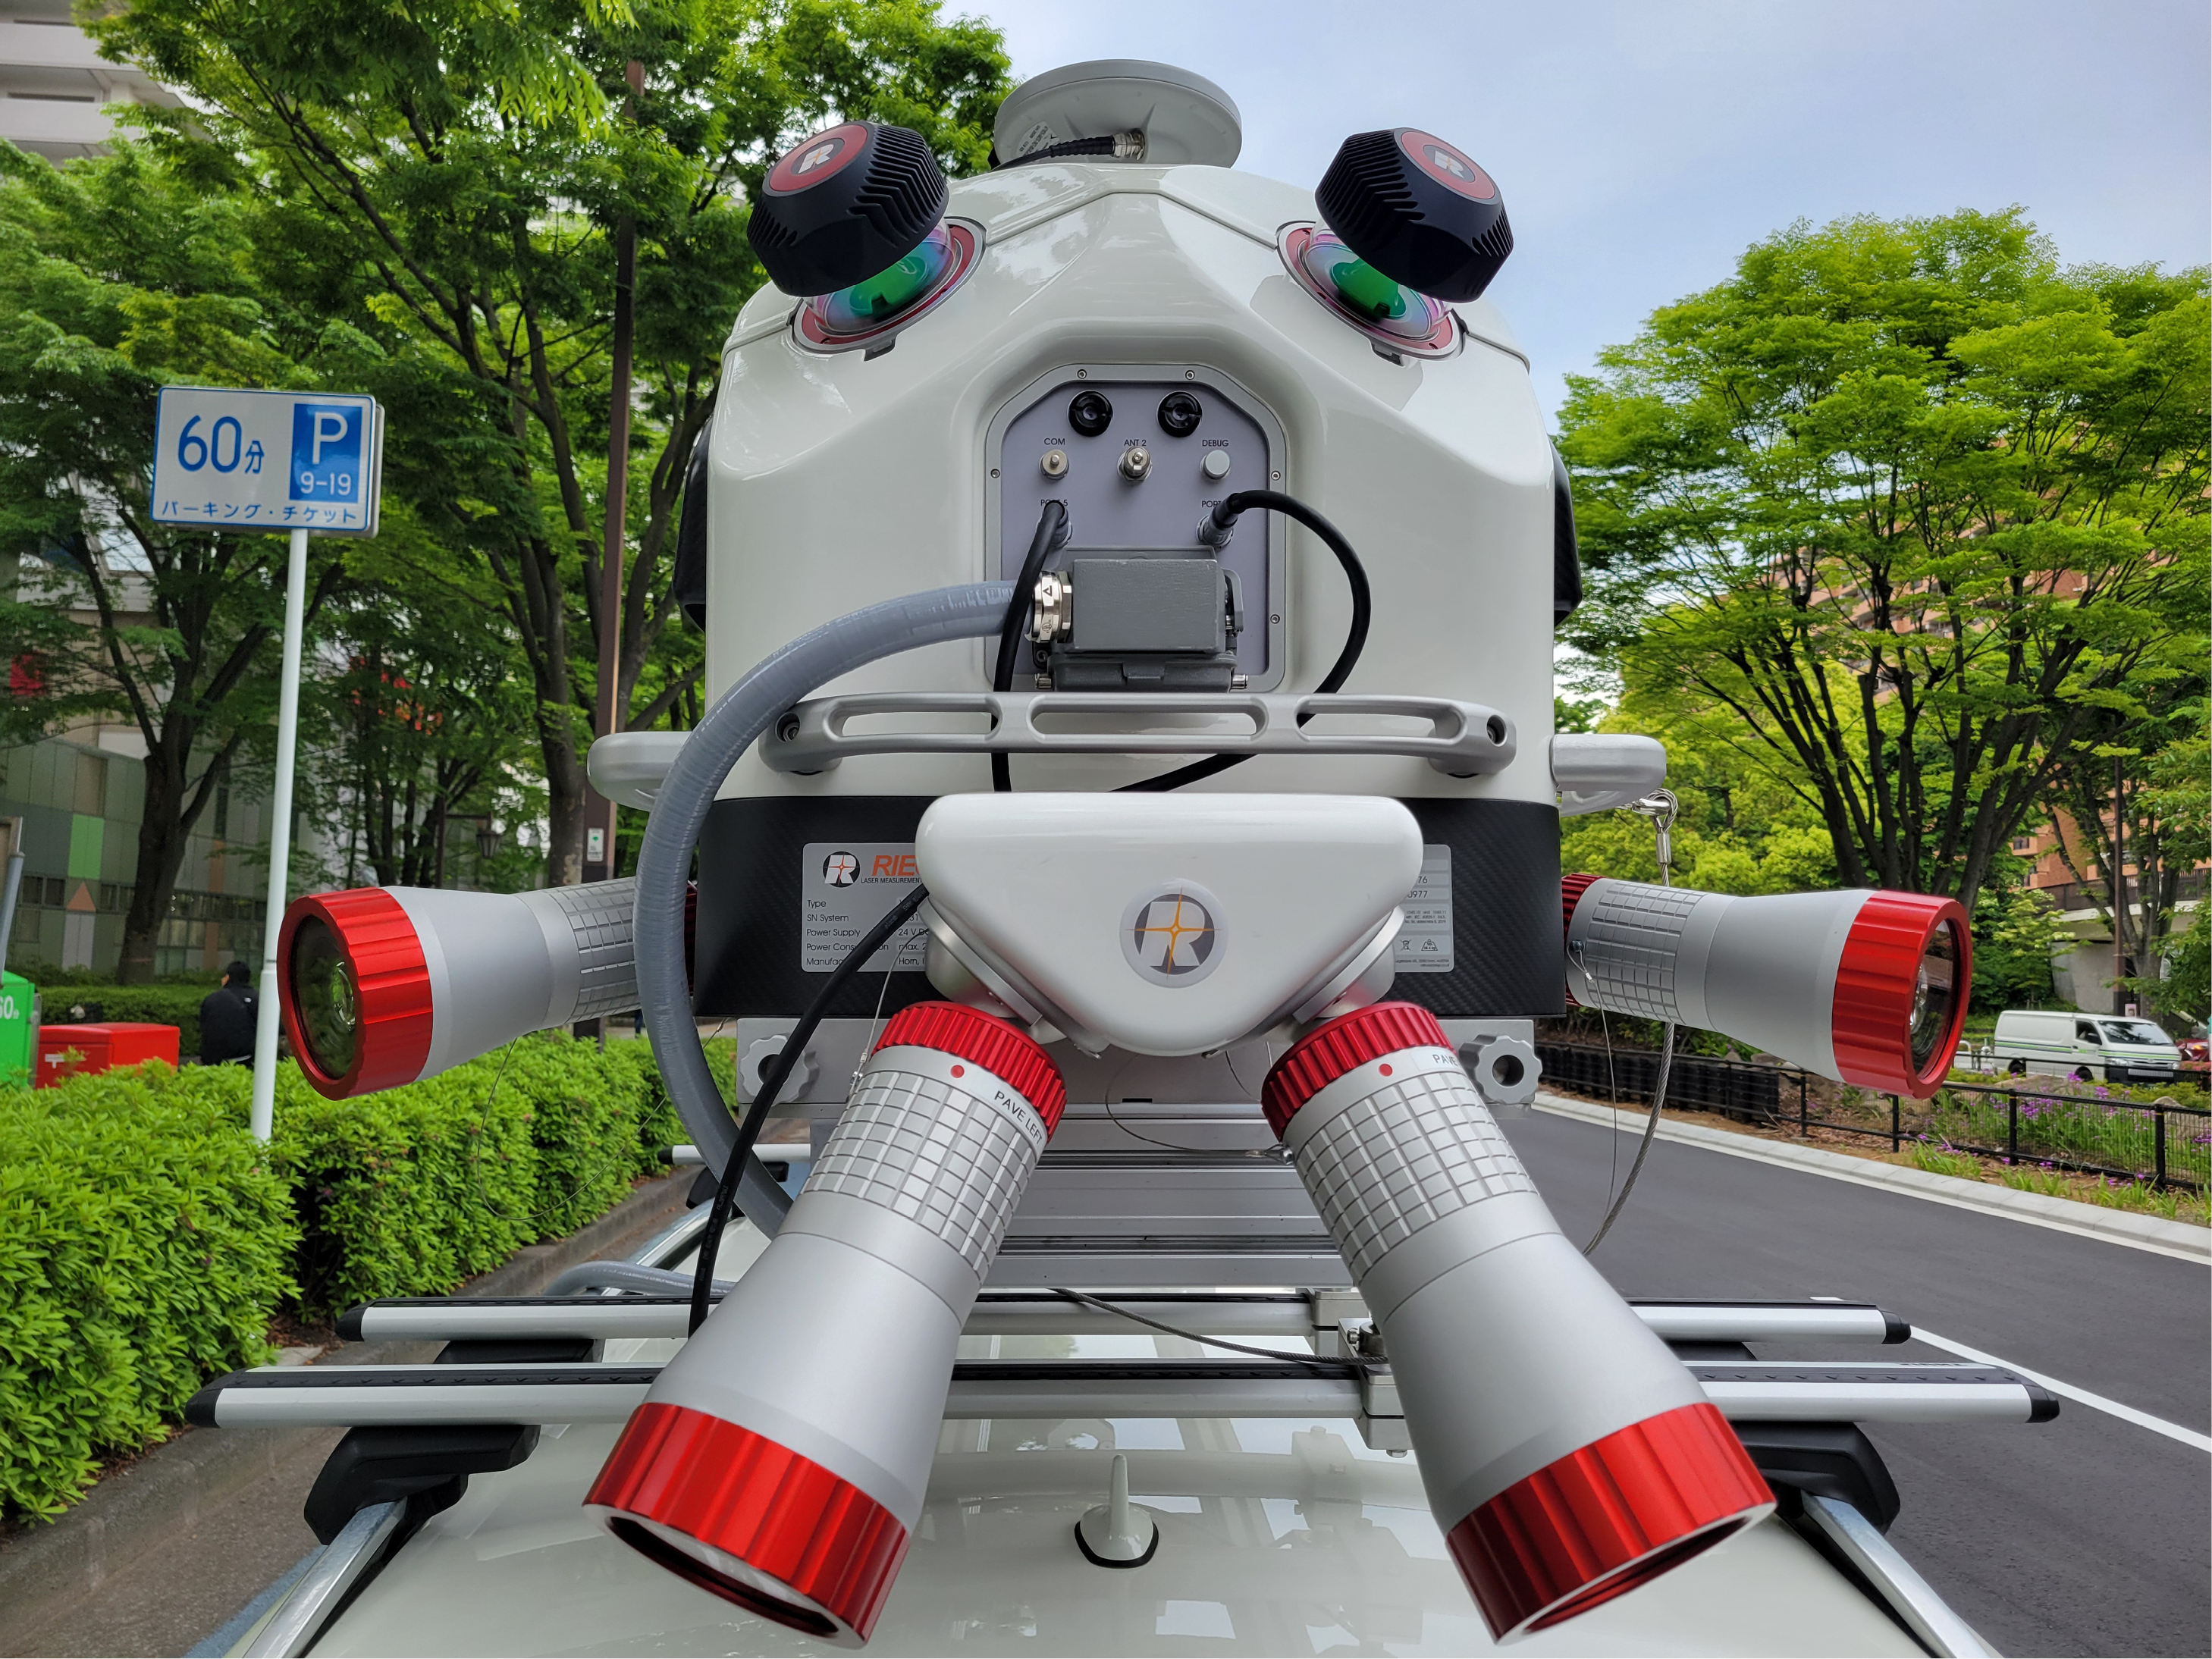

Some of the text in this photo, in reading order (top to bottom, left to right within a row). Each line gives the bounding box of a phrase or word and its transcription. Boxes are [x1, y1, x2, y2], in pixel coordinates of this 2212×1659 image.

[312, 412, 348, 465] P
[1043, 437, 1066, 447] COM
[1123, 439, 1147, 447] ANT 2
[1201, 439, 1229, 448] DEBUG
[177, 415, 265, 474] 60分
[300, 471, 352, 497] 9-19
[162, 500, 357, 525] パーキング・チケット
[871, 855, 920, 877] RIE
[807, 899, 827, 908] Type
[806, 914, 818, 922] SN
[820, 914, 849, 924] System
[806, 928, 832, 936] Power
[833, 928, 861, 938] Supply
[898, 928, 908, 936] 24
[806, 942, 831, 951] Power
[994, 1090, 1043, 1145] PAVE LEFT
